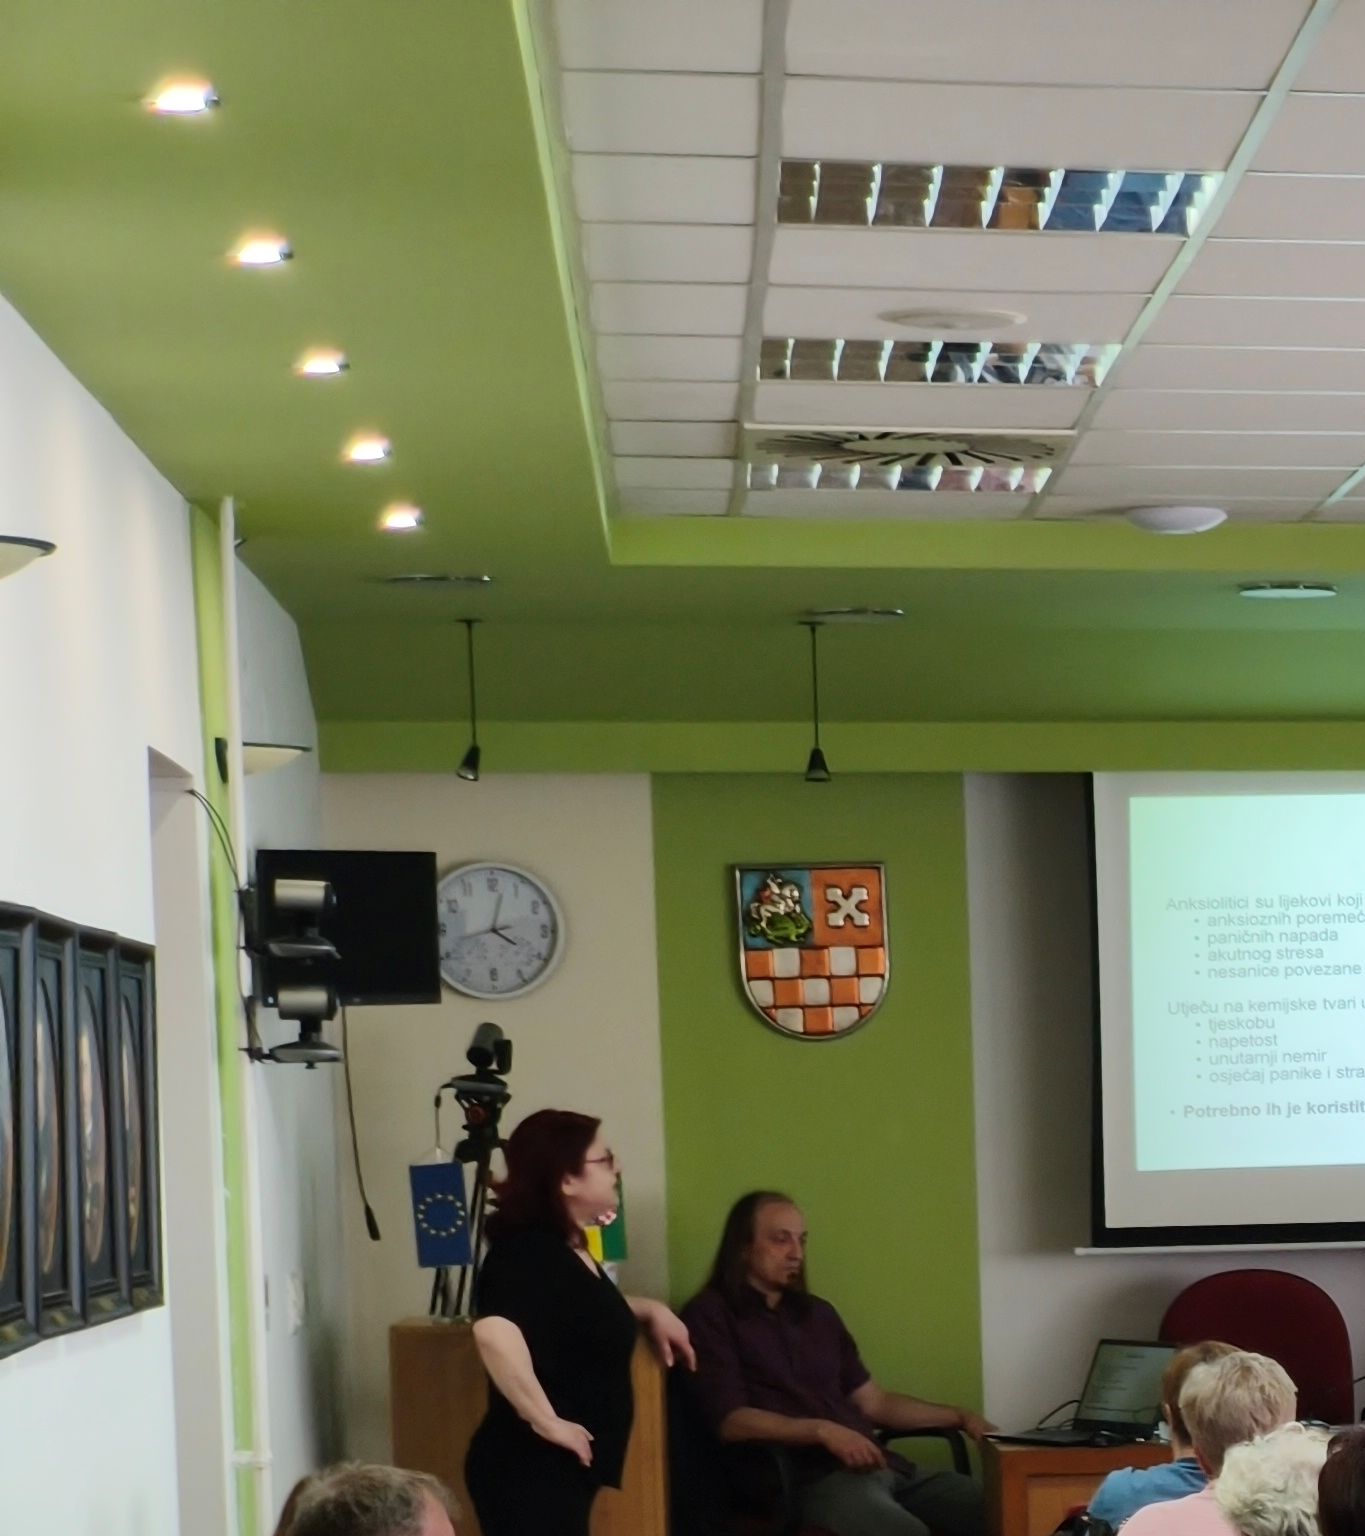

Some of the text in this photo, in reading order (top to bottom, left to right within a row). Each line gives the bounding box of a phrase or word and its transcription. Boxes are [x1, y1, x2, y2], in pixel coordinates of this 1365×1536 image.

[1165, 896, 1249, 911] Anksiolitici
[1255, 898, 1274, 909] su
[1278, 893, 1332, 910] lijekovi
[1337, 893, 1363, 910] koji
[1207, 912, 1291, 927] anksioznih
[1279, 928, 1338, 944] napada
[1207, 946, 1323, 963] akutnog stresa
[1207, 965, 1279, 980] nesanice
[1284, 962, 1361, 979] povezane
[1224, 1002, 1244, 1013] na
[1248, 998, 1317, 1014] kemijske
[1322, 996, 1356, 1011] tvari
[1208, 1017, 1276, 1034] tjeskobu
[1208, 1034, 1278, 1050] napetost
[1282, 1049, 1327, 1063] nemir
[1269, 1065, 1323, 1082] panike
[1183, 1103, 1261, 1118] Potrebno
[1286, 1101, 1302, 1118] je
